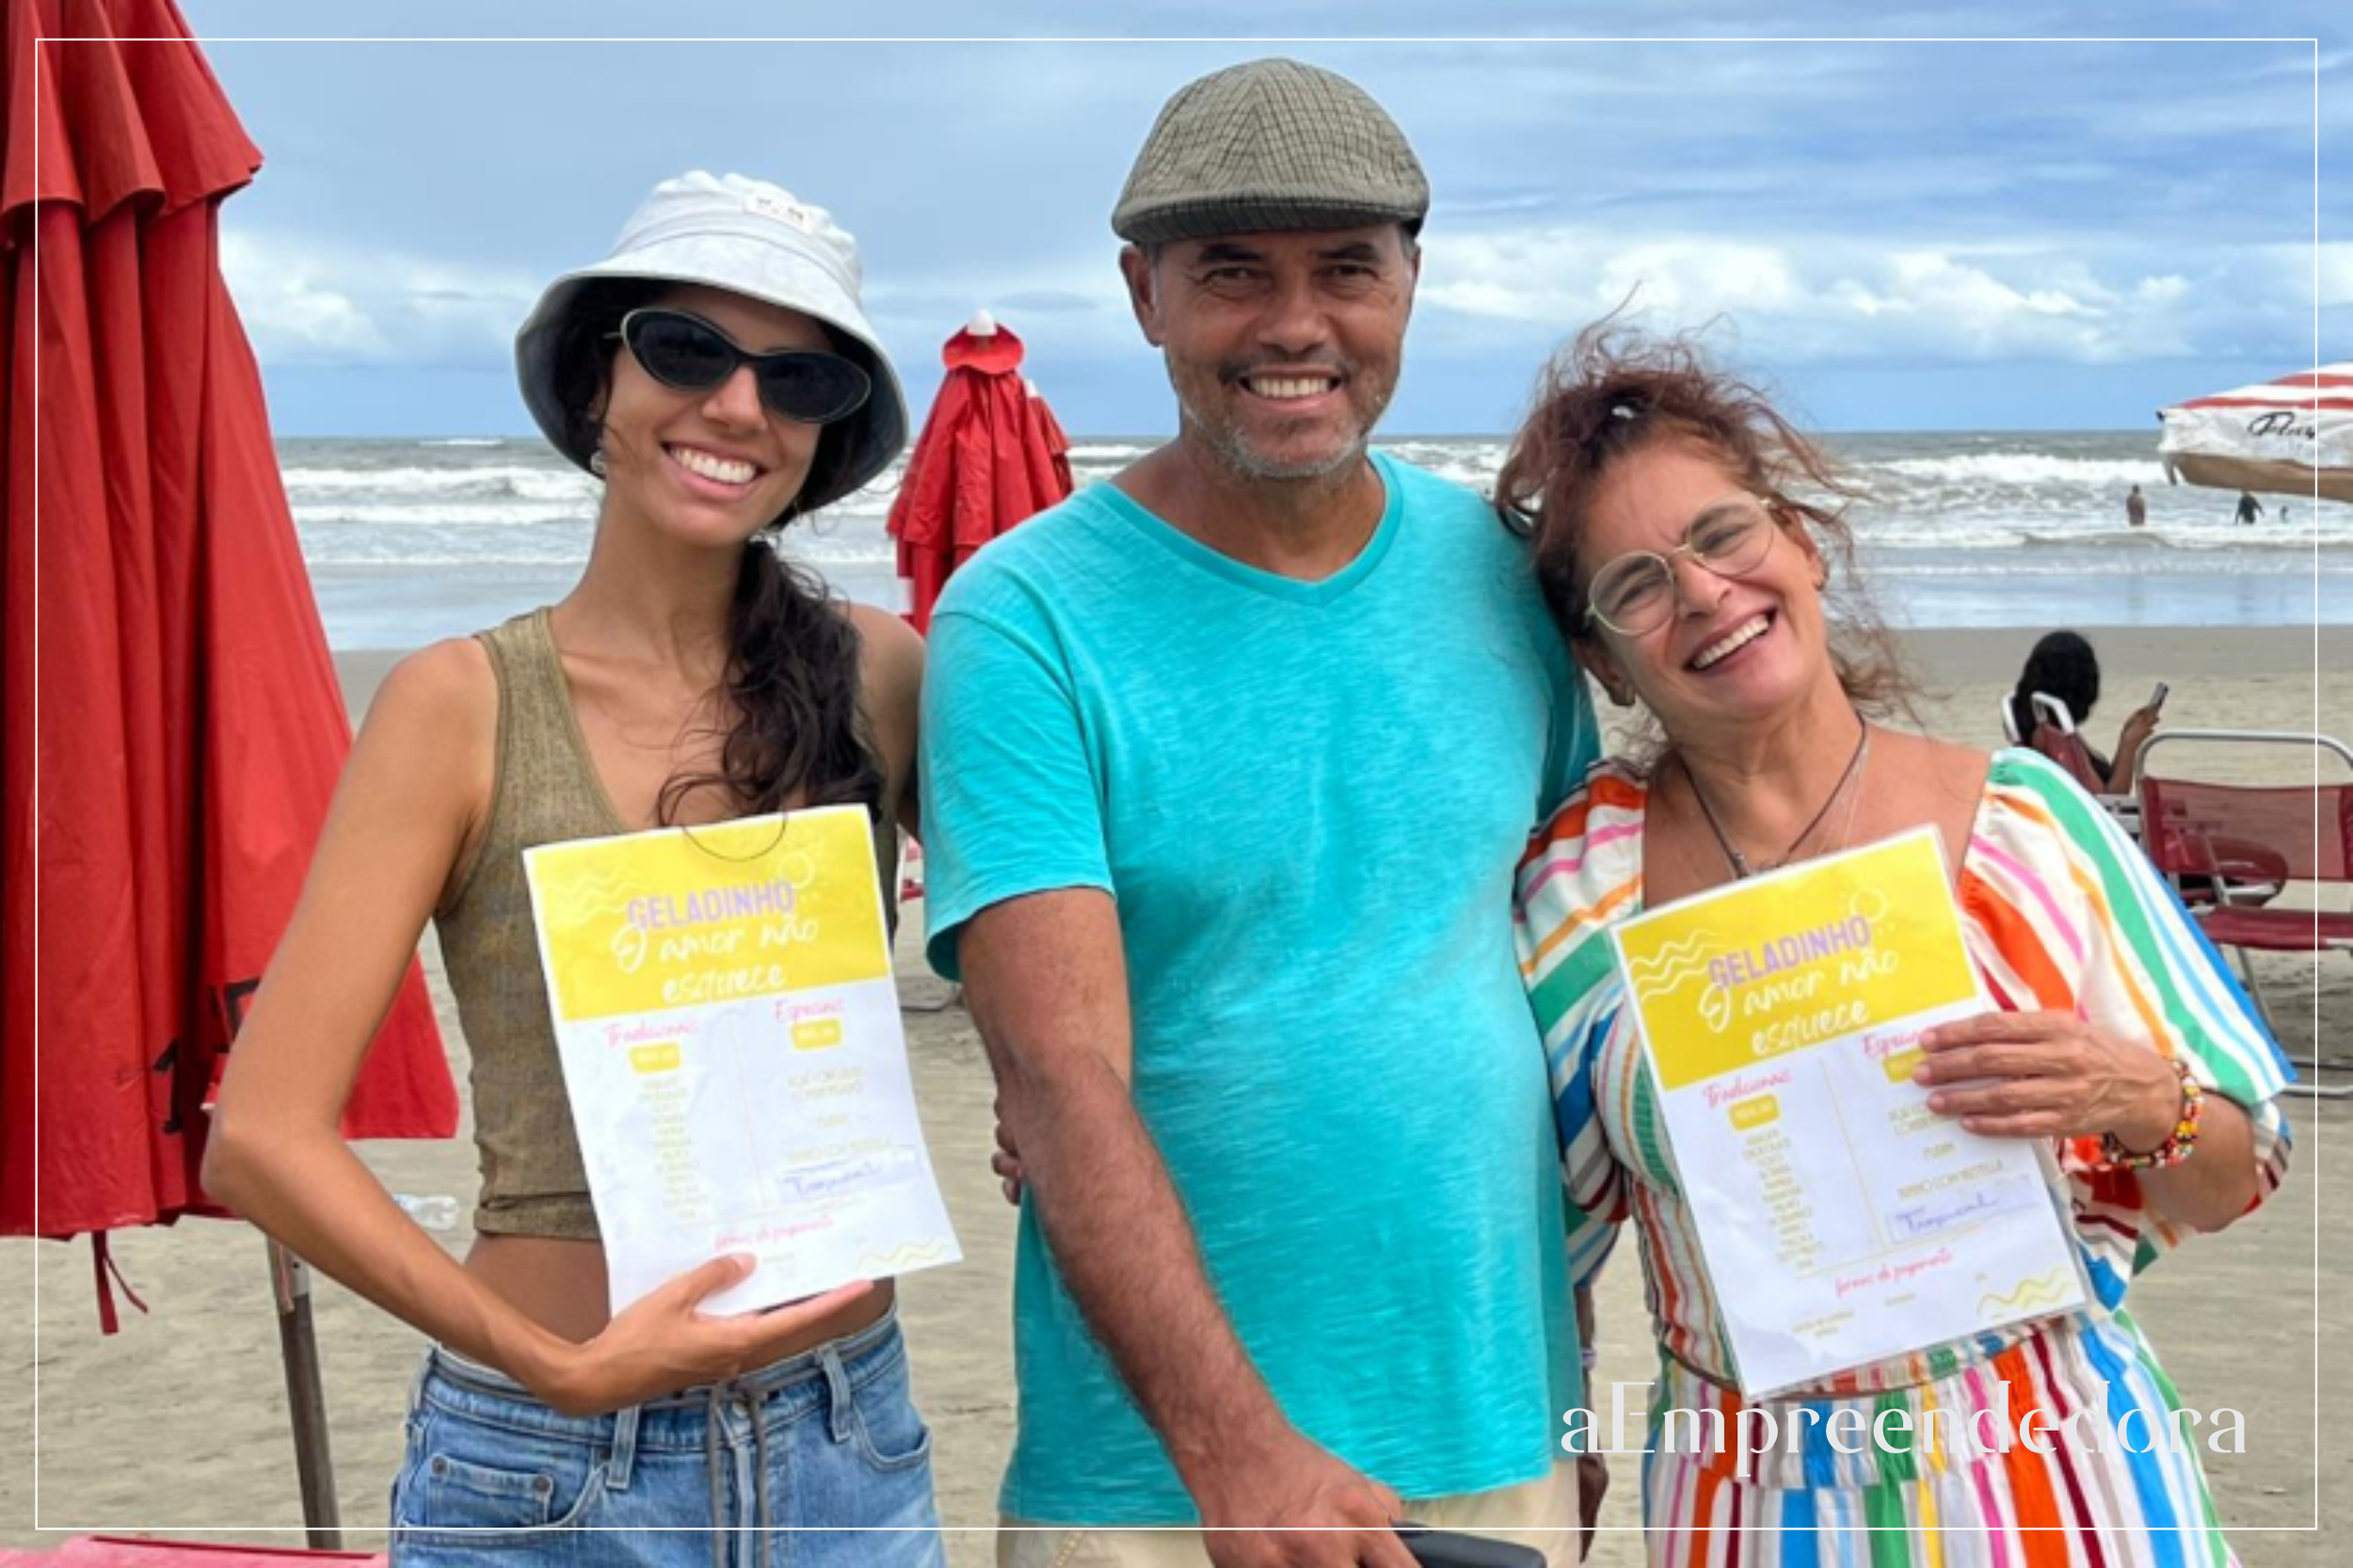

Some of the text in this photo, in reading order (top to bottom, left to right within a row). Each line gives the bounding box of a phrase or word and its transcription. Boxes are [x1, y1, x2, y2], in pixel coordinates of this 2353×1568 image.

[627, 879, 795, 930] GELADINHO
[659, 927, 745, 962] amor
[760, 912, 820, 950] não
[1707, 914, 1871, 989] GELADINHO
[662, 963, 787, 1005] esquece
[1743, 972, 1826, 1016] amor
[1840, 944, 1898, 985] não
[1751, 1000, 1869, 1054] esquece
